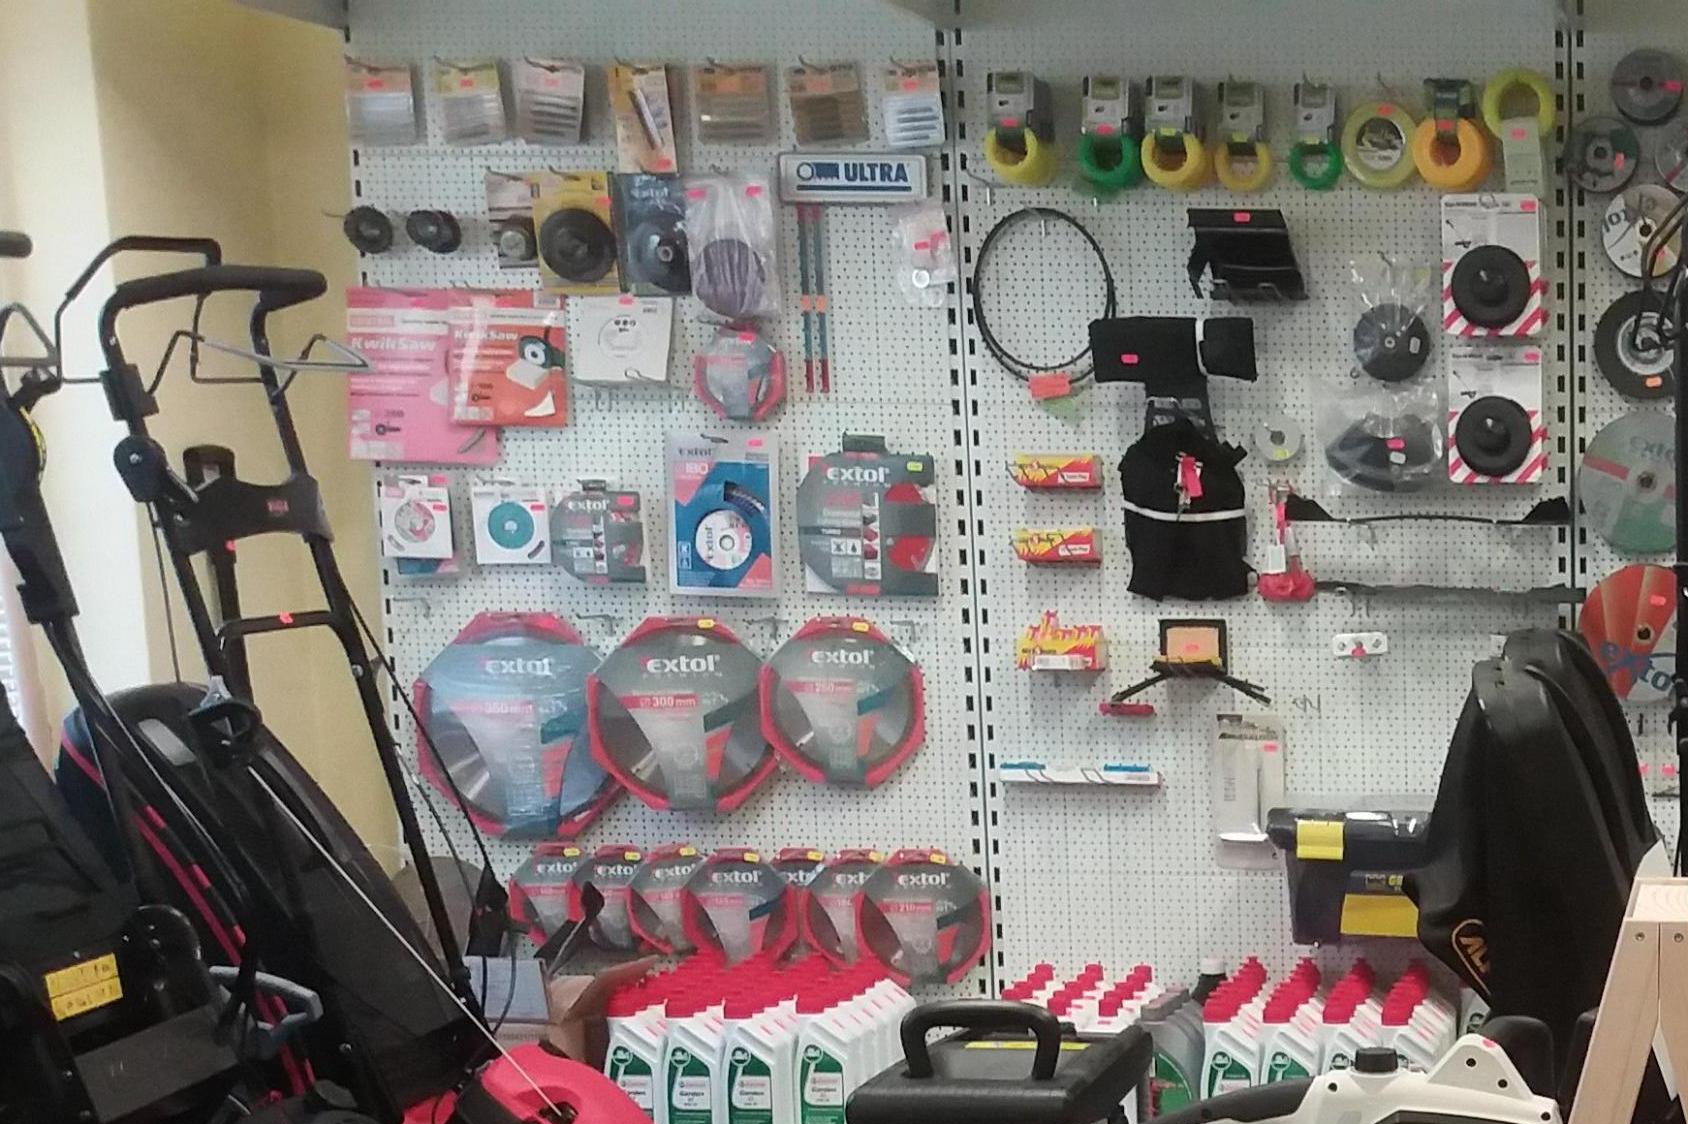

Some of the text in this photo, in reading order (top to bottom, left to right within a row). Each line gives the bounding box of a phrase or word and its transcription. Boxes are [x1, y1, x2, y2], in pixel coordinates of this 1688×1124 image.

[844, 162, 909, 183] ULTRA
[827, 467, 890, 483] extol
[646, 657, 718, 673] extol
[811, 649, 874, 665] extol
[485, 658, 553, 675] extol
[711, 871, 762, 884] extol
[898, 872, 950, 886] extol
